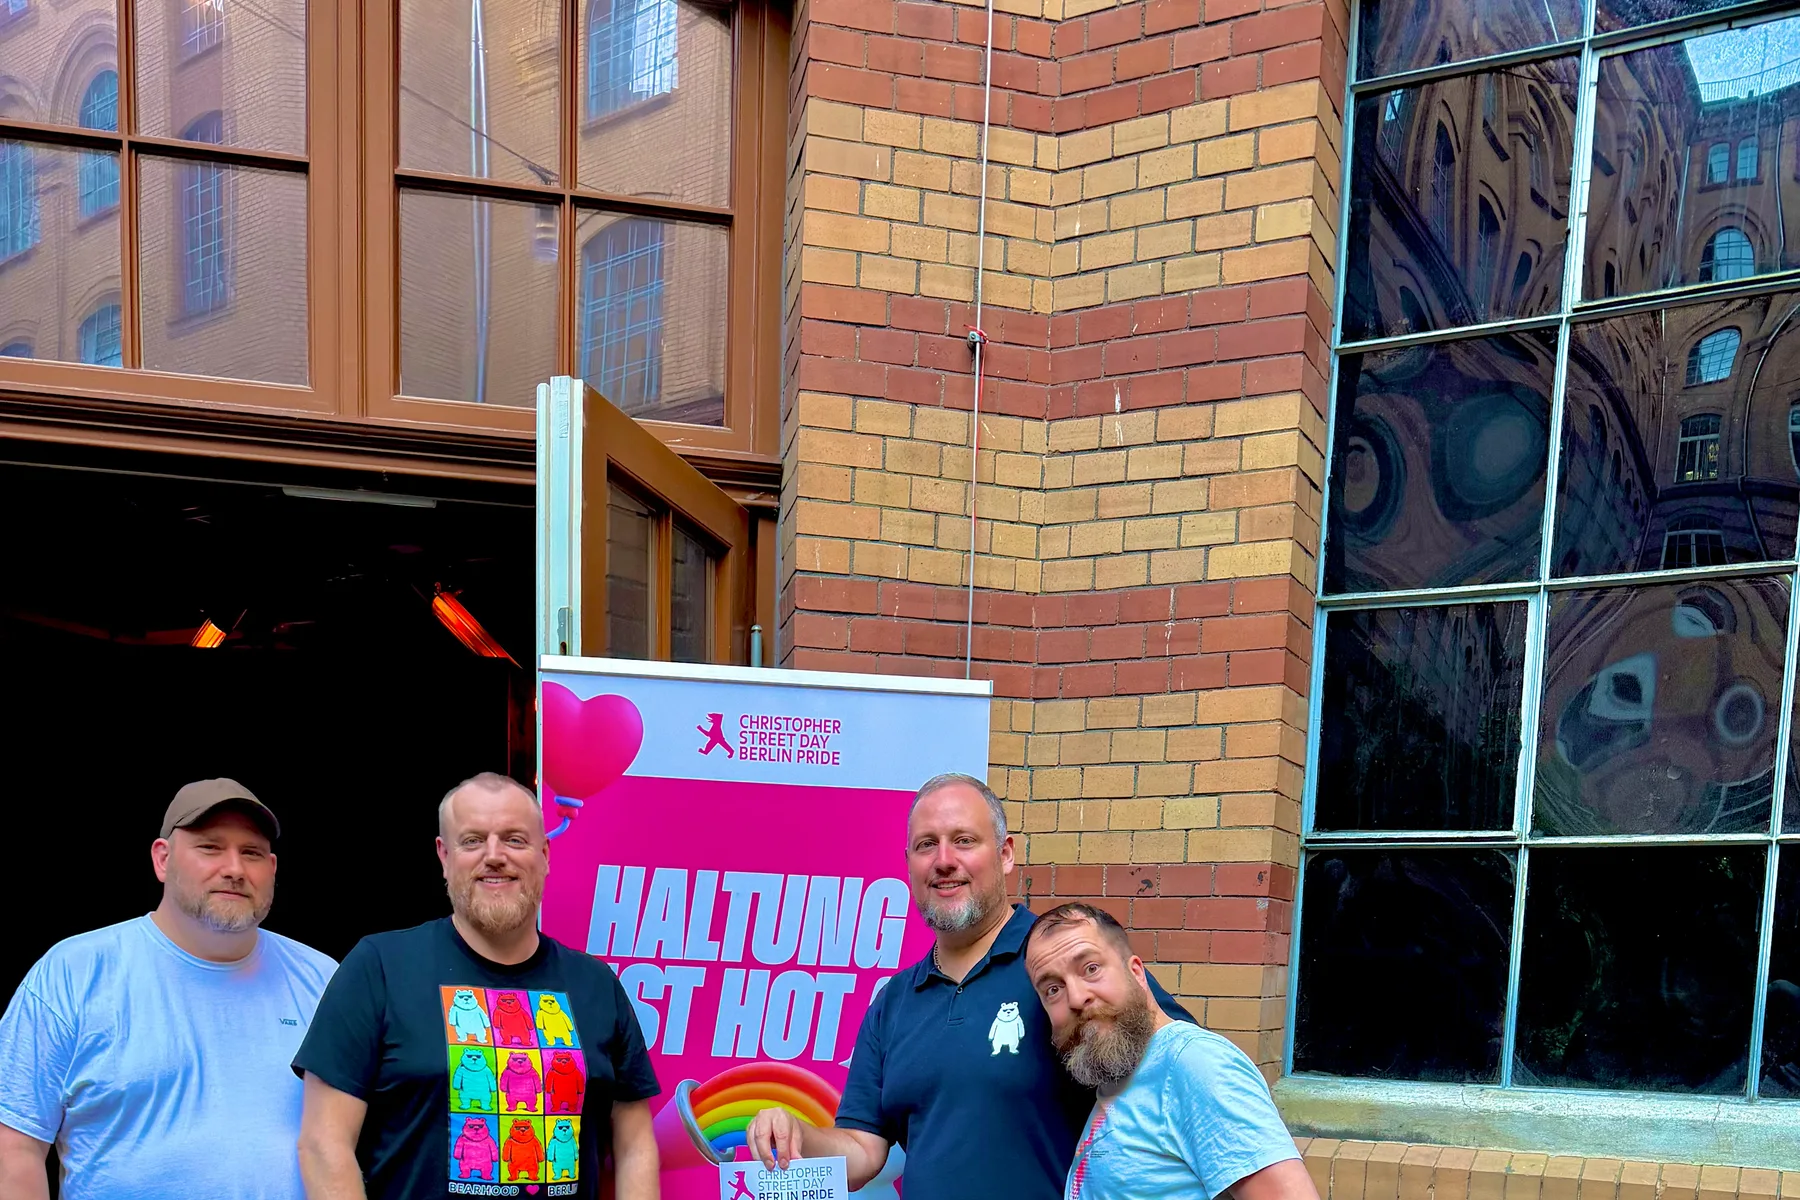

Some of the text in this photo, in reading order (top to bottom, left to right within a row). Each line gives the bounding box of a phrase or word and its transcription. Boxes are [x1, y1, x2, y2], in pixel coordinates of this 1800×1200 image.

[739, 714, 841, 734] CHRISTOPHER
[739, 731, 830, 749] STREET DAY
[739, 746, 841, 765] BERLIN PRIDE
[585, 864, 911, 969] HALTUNG
[607, 962, 857, 1062] ST HOT
[757, 1166, 833, 1180] CHRISTOPHER
[448, 1182, 519, 1196] BEARHOOD
[758, 1177, 825, 1192] STREET DAY
[801, 1188, 835, 1200] PRIDE
